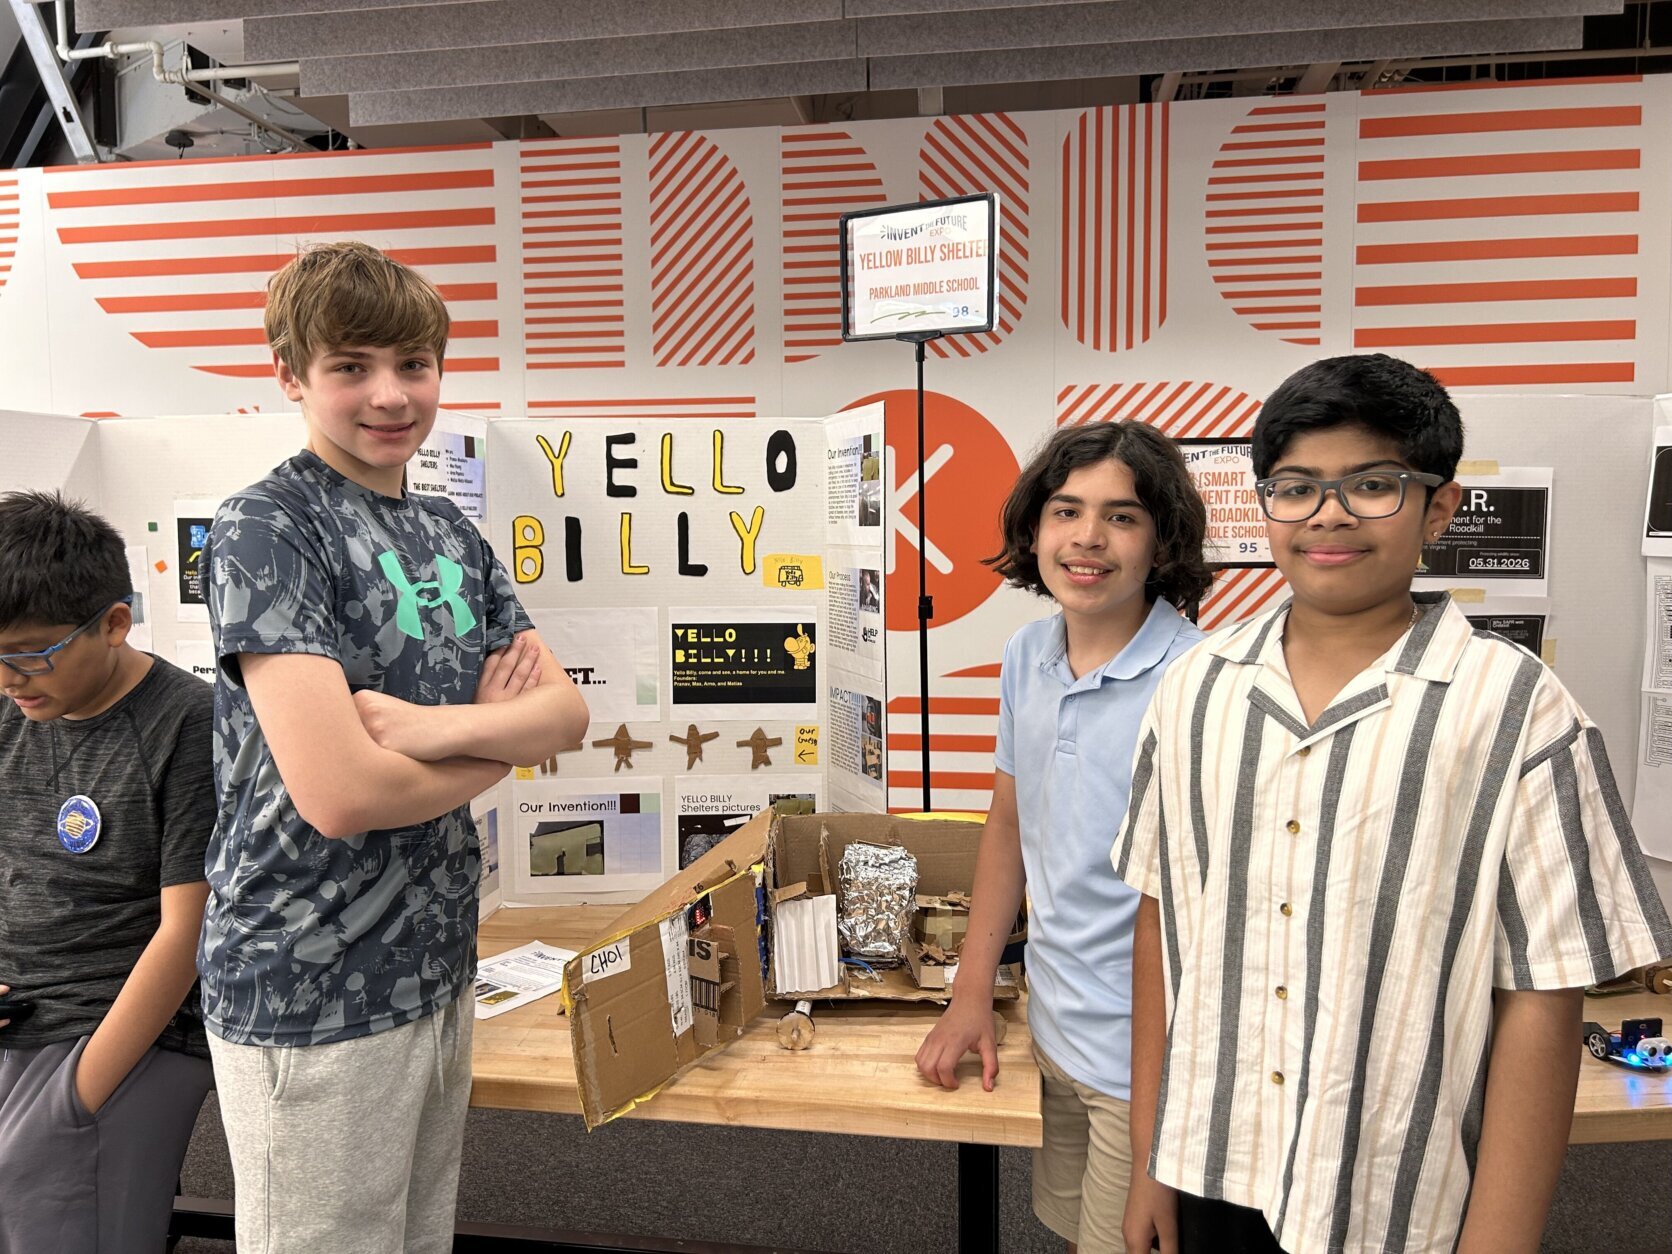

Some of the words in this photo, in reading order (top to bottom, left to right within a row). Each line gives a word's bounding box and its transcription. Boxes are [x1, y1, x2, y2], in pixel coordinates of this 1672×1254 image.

[886, 223, 924, 241] INVENT
[935, 215, 967, 231] FUTURE
[859, 249, 903, 271] YELLOW
[906, 244, 936, 266] BILLY
[869, 284, 911, 300] PARKLAND
[913, 281, 944, 296] MIDDLE
[946, 277, 980, 293] SCHOOL
[536, 429, 797, 498] YELLO
[1214, 456, 1240, 464] EXPO
[1234, 490, 1257, 505] FOR
[1472, 515, 1485, 524] for
[1487, 516, 1502, 524] the
[1449, 524, 1484, 533] Roadkill
[512, 505, 764, 584] BILLY
[1239, 543, 1258, 553] 95
[1469, 558, 1530, 569] 05.31.2026
[674, 628, 737, 643] YELLO
[681, 794, 708, 804] YELLO
[710, 794, 733, 804] BILLY
[519, 802, 544, 813] Our
[548, 800, 617, 812] Invention!!!
[681, 803, 720, 813] Shelters
[722, 803, 761, 814] pictures
